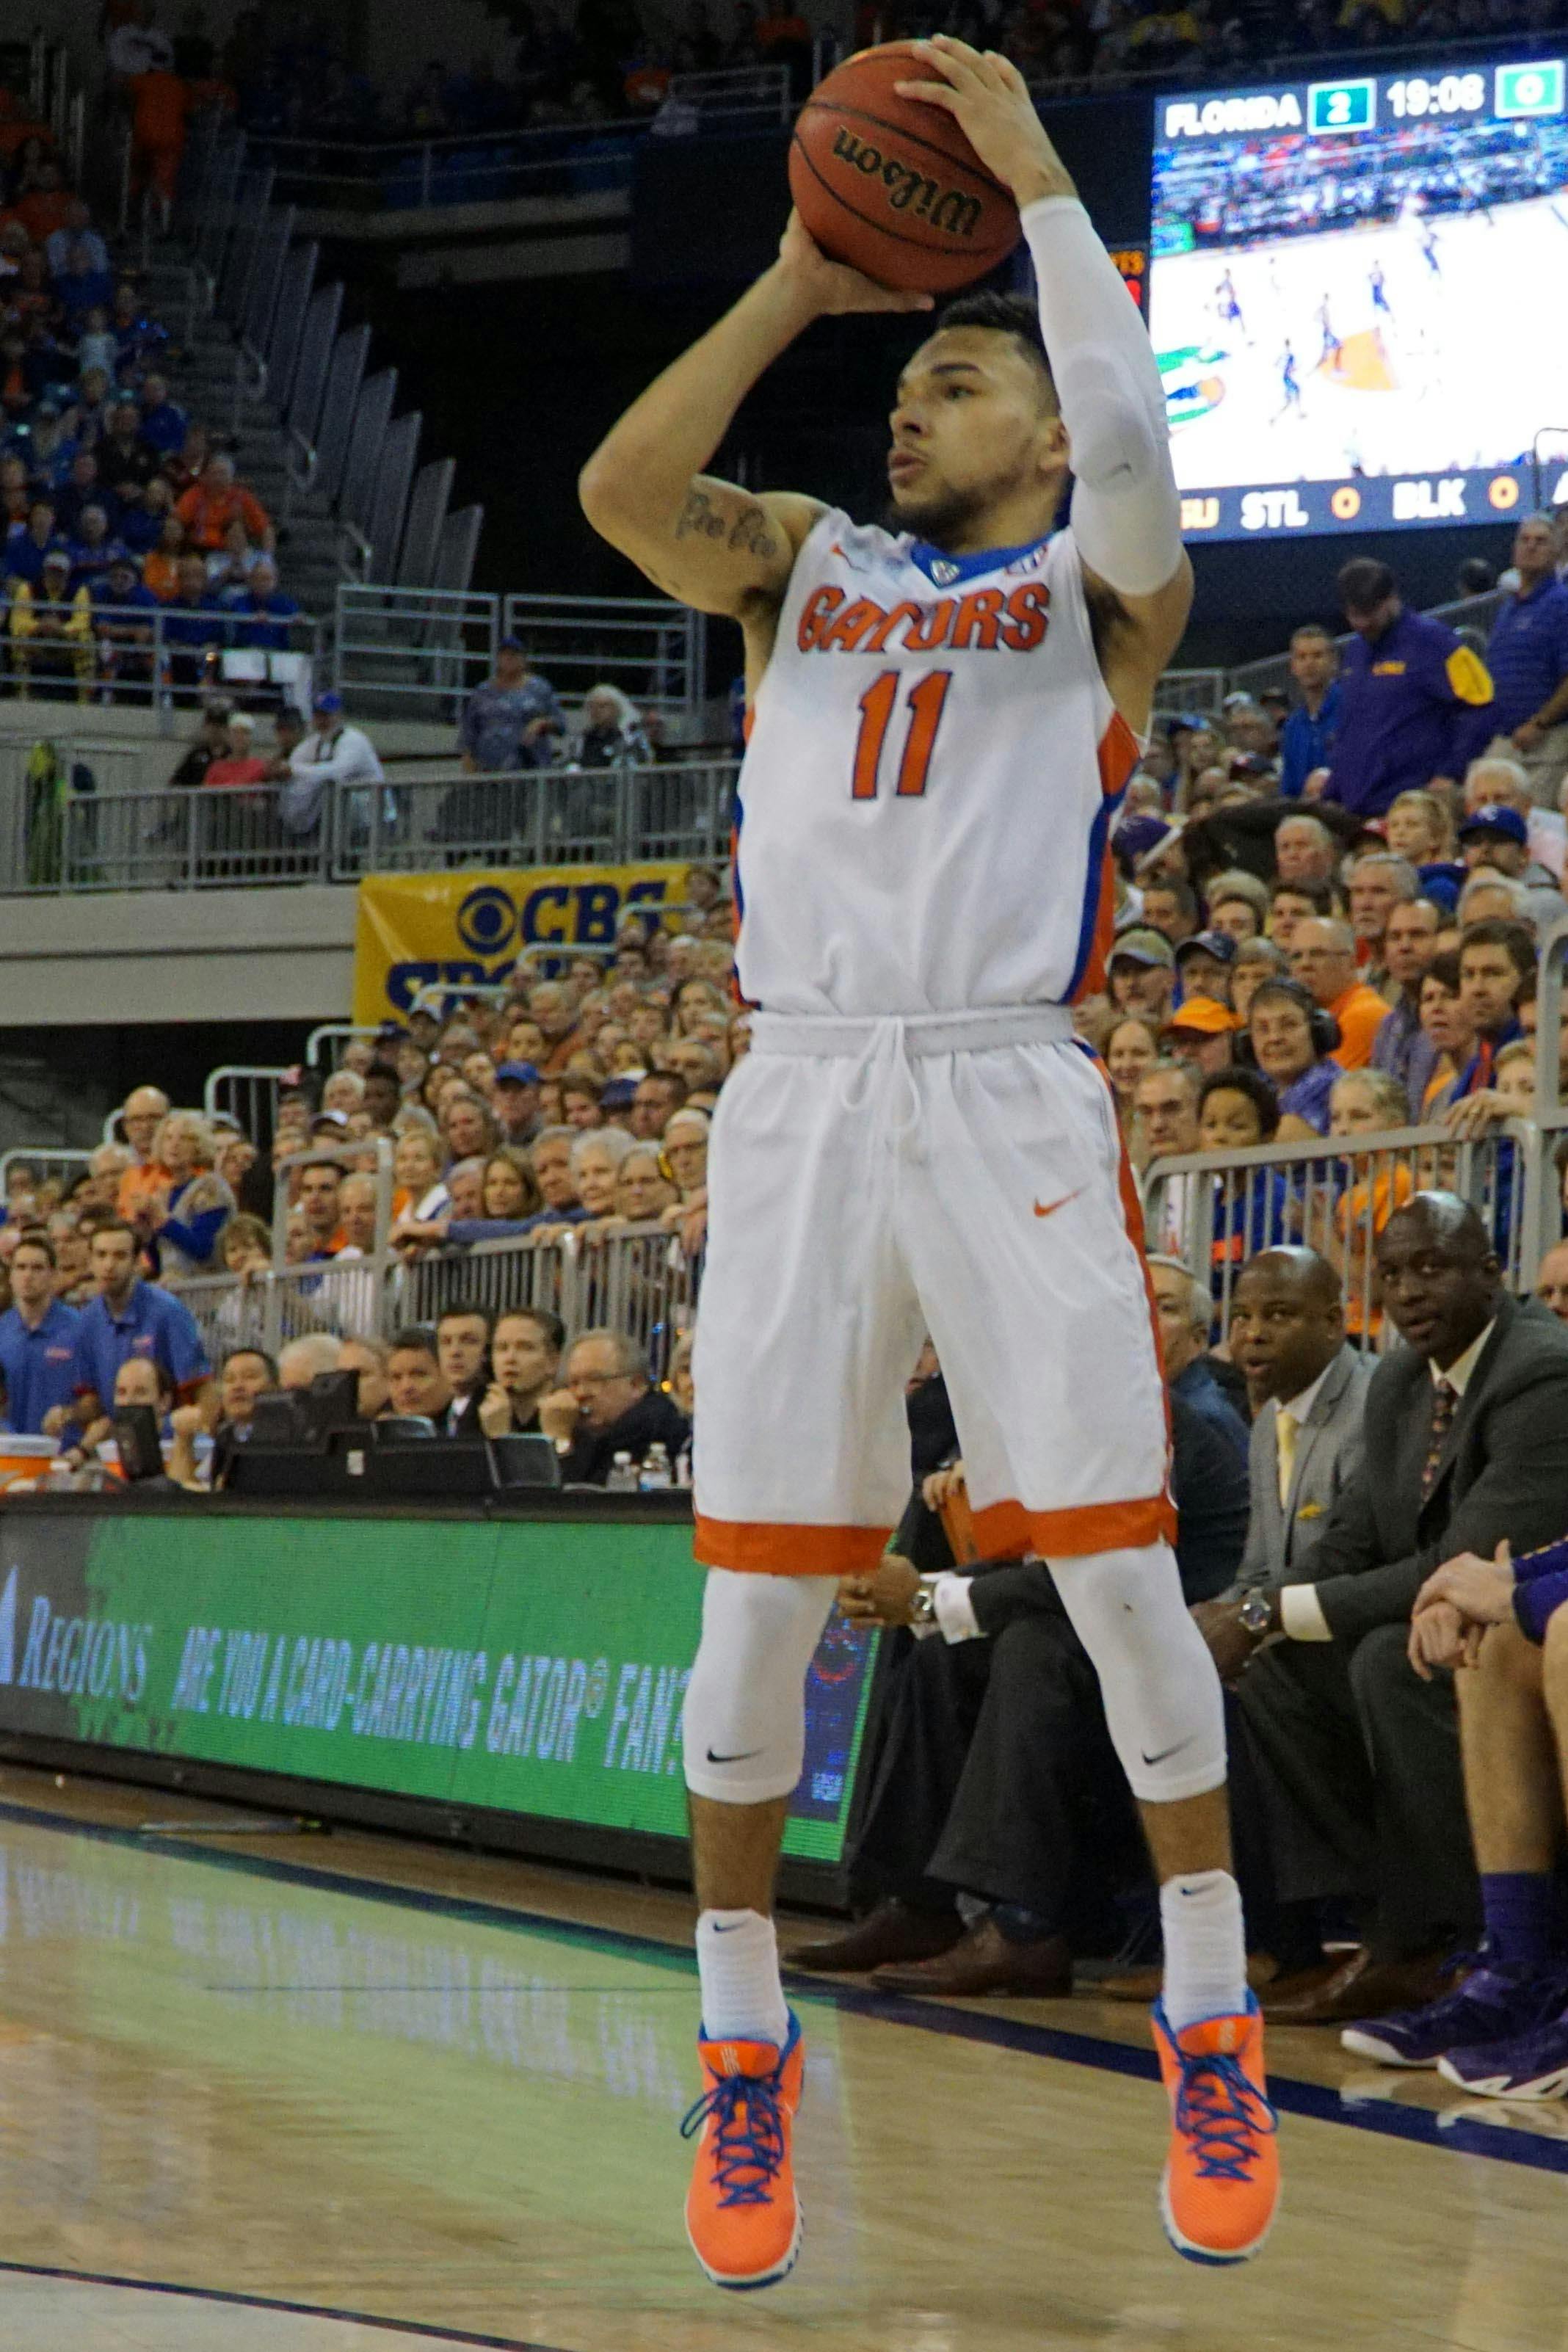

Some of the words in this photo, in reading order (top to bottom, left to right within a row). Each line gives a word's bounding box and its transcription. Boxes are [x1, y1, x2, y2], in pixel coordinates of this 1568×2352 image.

[1166, 93, 1302, 137] FLORIDA
[1326, 91, 1351, 124] 2
[1387, 73, 1485, 117] 19:08
[1515, 74, 1545, 106] 0
[832, 125, 983, 236] Wilson
[1241, 489, 1310, 530] STL
[1330, 486, 1362, 520] 0
[1393, 477, 1467, 520] BLK
[1487, 475, 1520, 509] 0
[852, 669, 954, 800] 11
